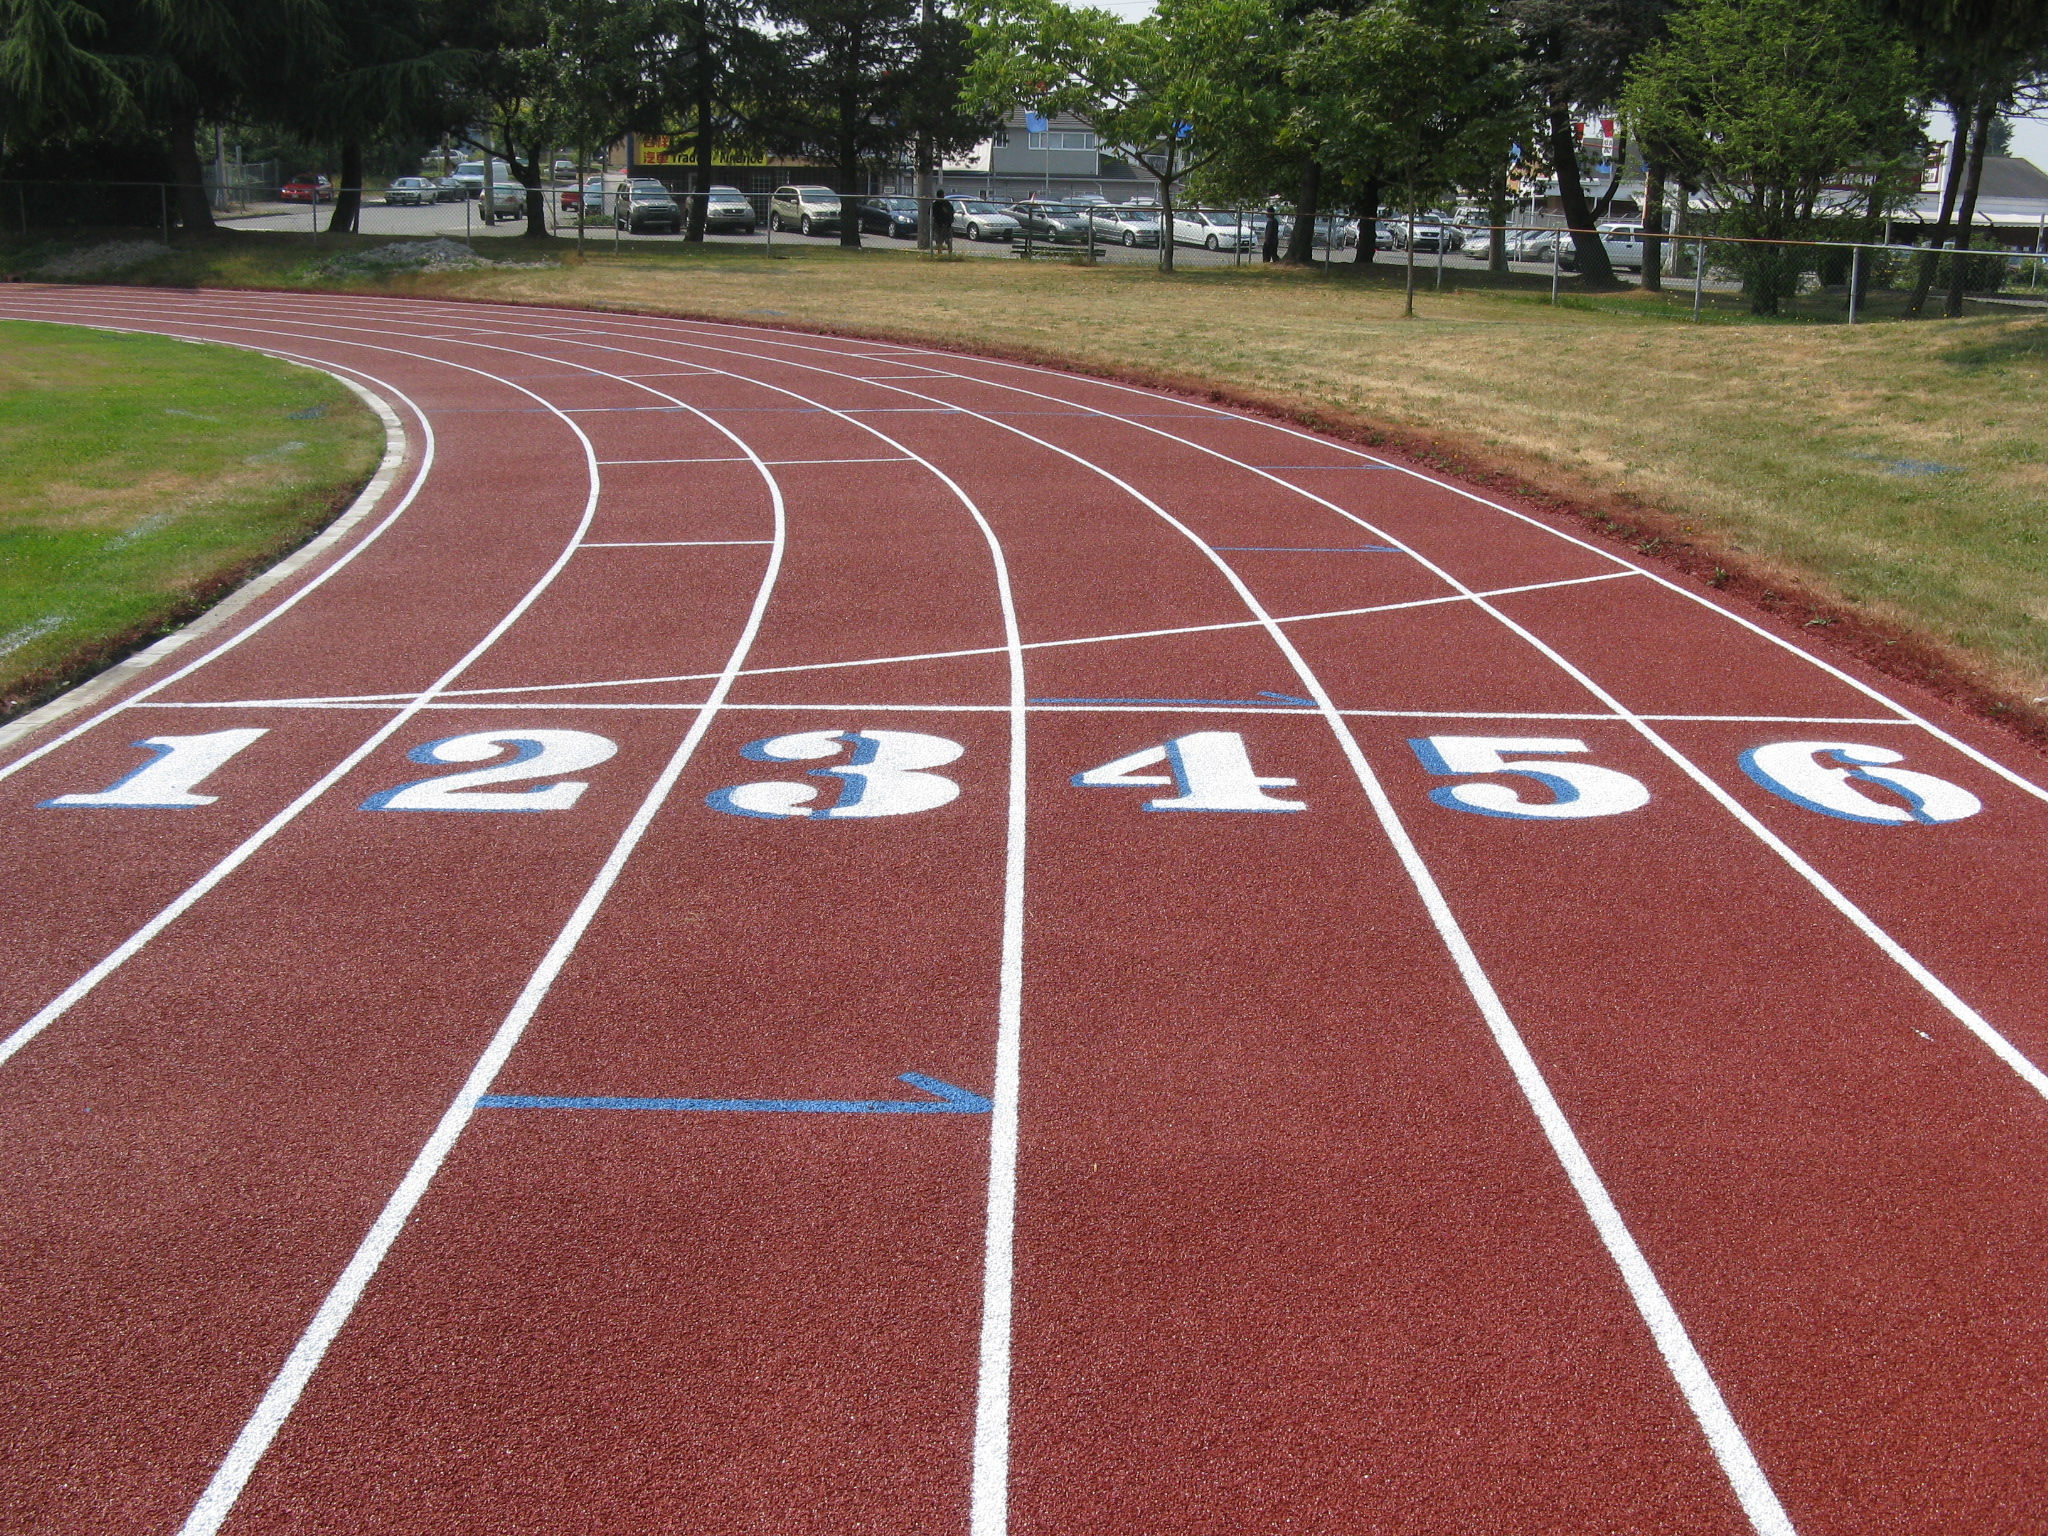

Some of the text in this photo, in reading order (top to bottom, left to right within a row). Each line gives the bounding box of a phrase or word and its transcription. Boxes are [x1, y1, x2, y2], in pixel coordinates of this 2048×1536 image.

[37, 727, 269, 811] 1
[357, 728, 620, 814] 2
[704, 729, 966, 821] 3
[1070, 730, 1308, 814] 4
[1407, 735, 1653, 822] 5
[1737, 739, 1985, 827] 6
